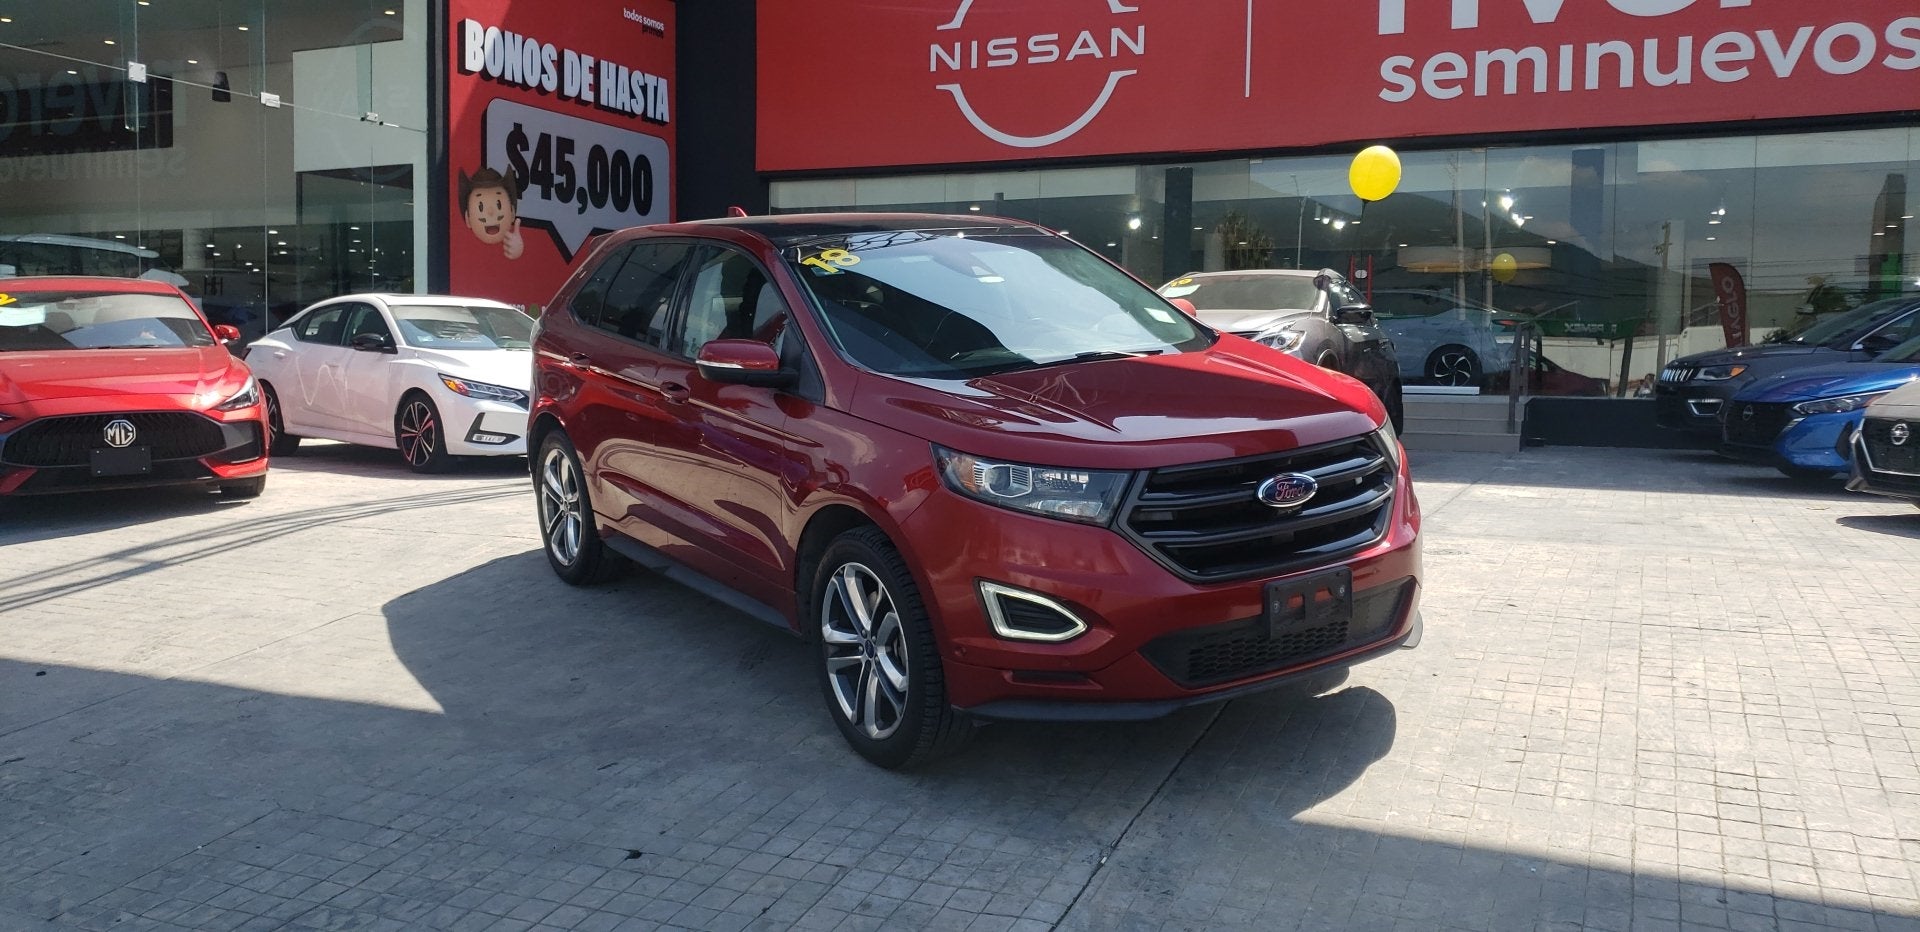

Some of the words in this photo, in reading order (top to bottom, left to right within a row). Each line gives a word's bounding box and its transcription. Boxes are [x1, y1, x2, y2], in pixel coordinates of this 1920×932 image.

[623, 7, 642, 24] todos
[642, 16, 664, 31] somos
[929, 25, 1145, 72] NISSAN
[1378, 16, 1920, 103] seminuevos
[463, 18, 558, 93] BONOS
[563, 48, 595, 103] DE
[599, 59, 670, 123] HASTA
[505, 122, 654, 217] $45,000
[802, 249, 861, 273] 18
[106, 422, 134, 445] MG
[1274, 480, 1306, 501] Ford
